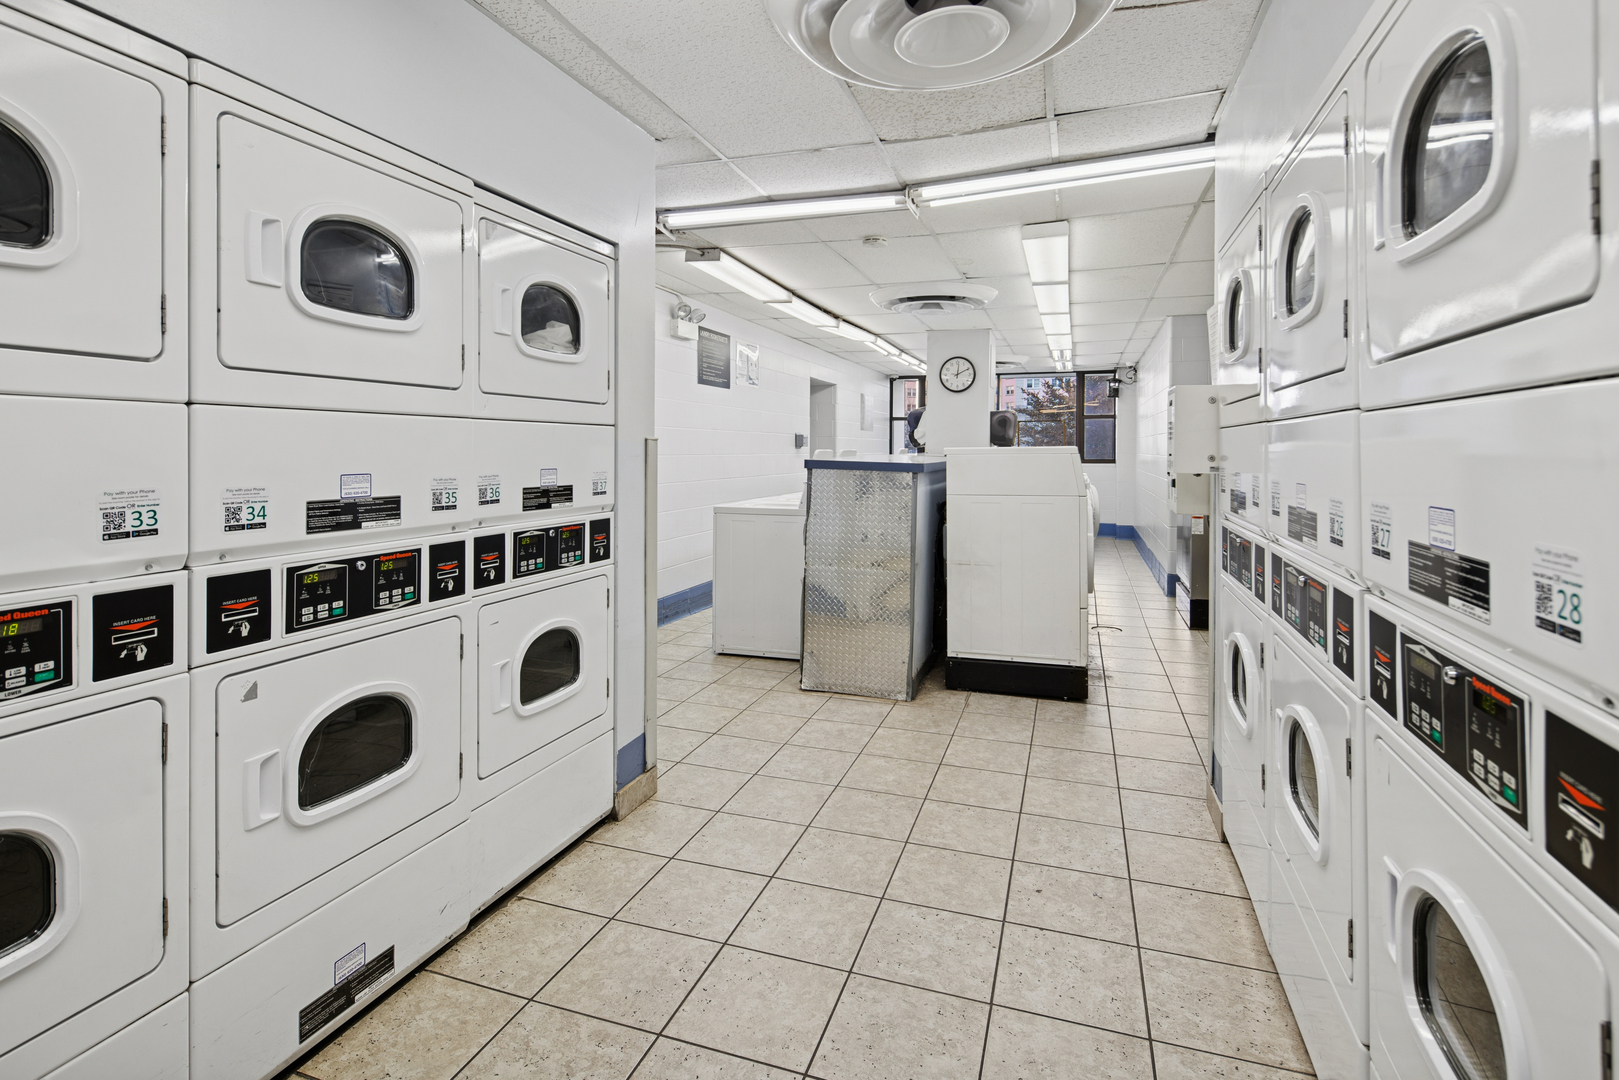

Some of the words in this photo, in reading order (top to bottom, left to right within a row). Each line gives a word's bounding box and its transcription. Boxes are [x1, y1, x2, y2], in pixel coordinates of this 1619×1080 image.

[489, 487, 500, 498] 36
[599, 481, 606, 490] 37
[445, 492, 457, 504] 35
[131, 509, 158, 528] 33
[246, 505, 267, 521] 34
[1336, 520, 1343, 537] 26
[1380, 528, 1390, 548] 27
[13, 608, 48, 619] Queen
[1557, 589, 1581, 624] 28
